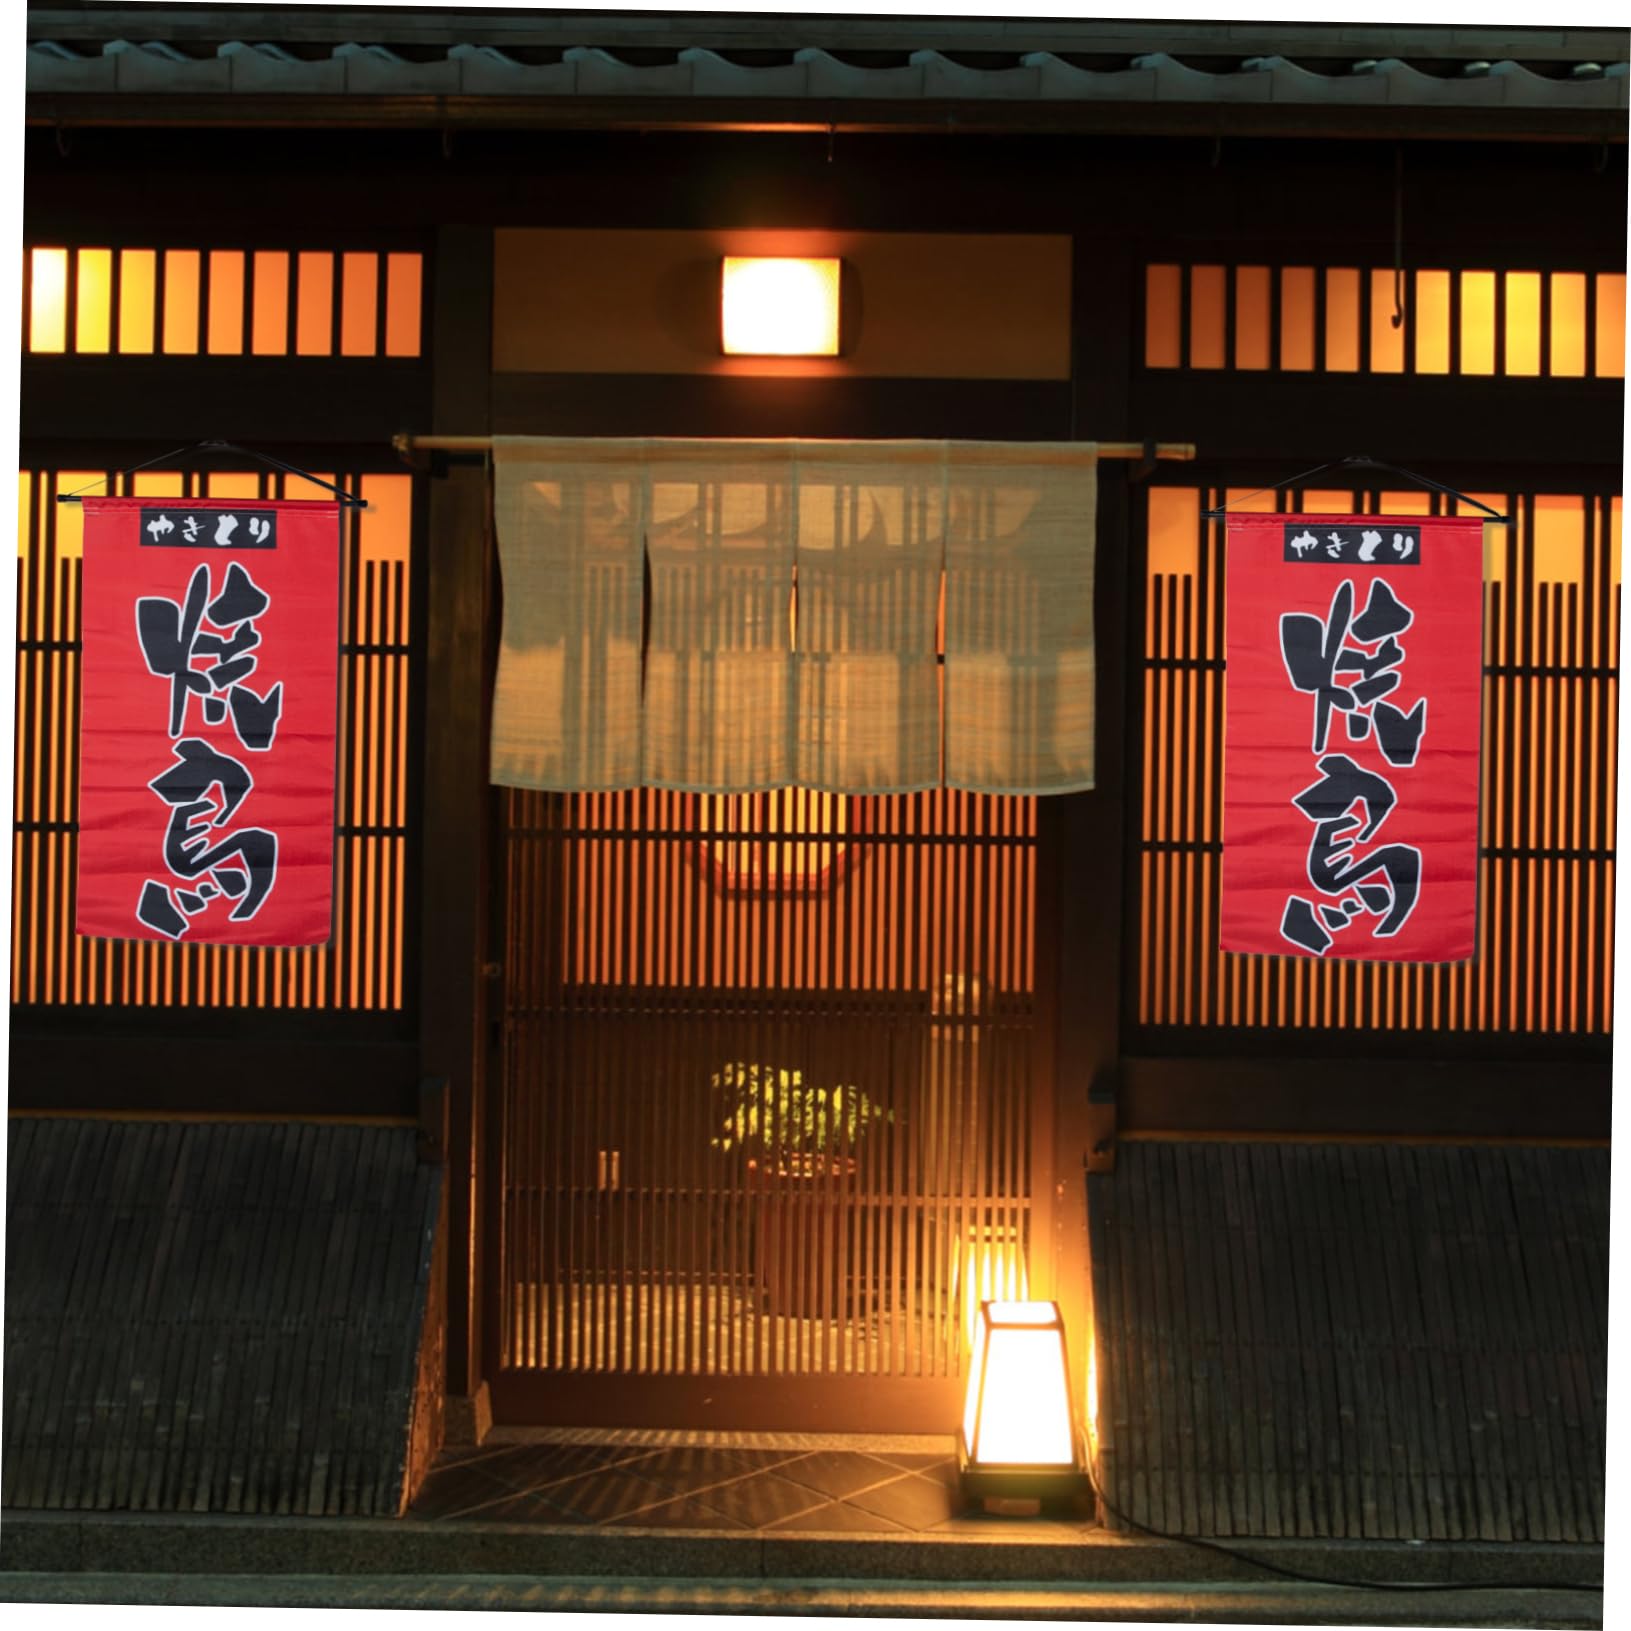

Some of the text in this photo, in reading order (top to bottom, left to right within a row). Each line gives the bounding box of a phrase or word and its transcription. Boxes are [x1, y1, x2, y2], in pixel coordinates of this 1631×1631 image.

[146, 514, 271, 545] やきとり
[1290, 530, 1415, 561] やきとり
[136, 562, 283, 939] 焼鳥
[1279, 577, 1426, 955] 焼鳥
